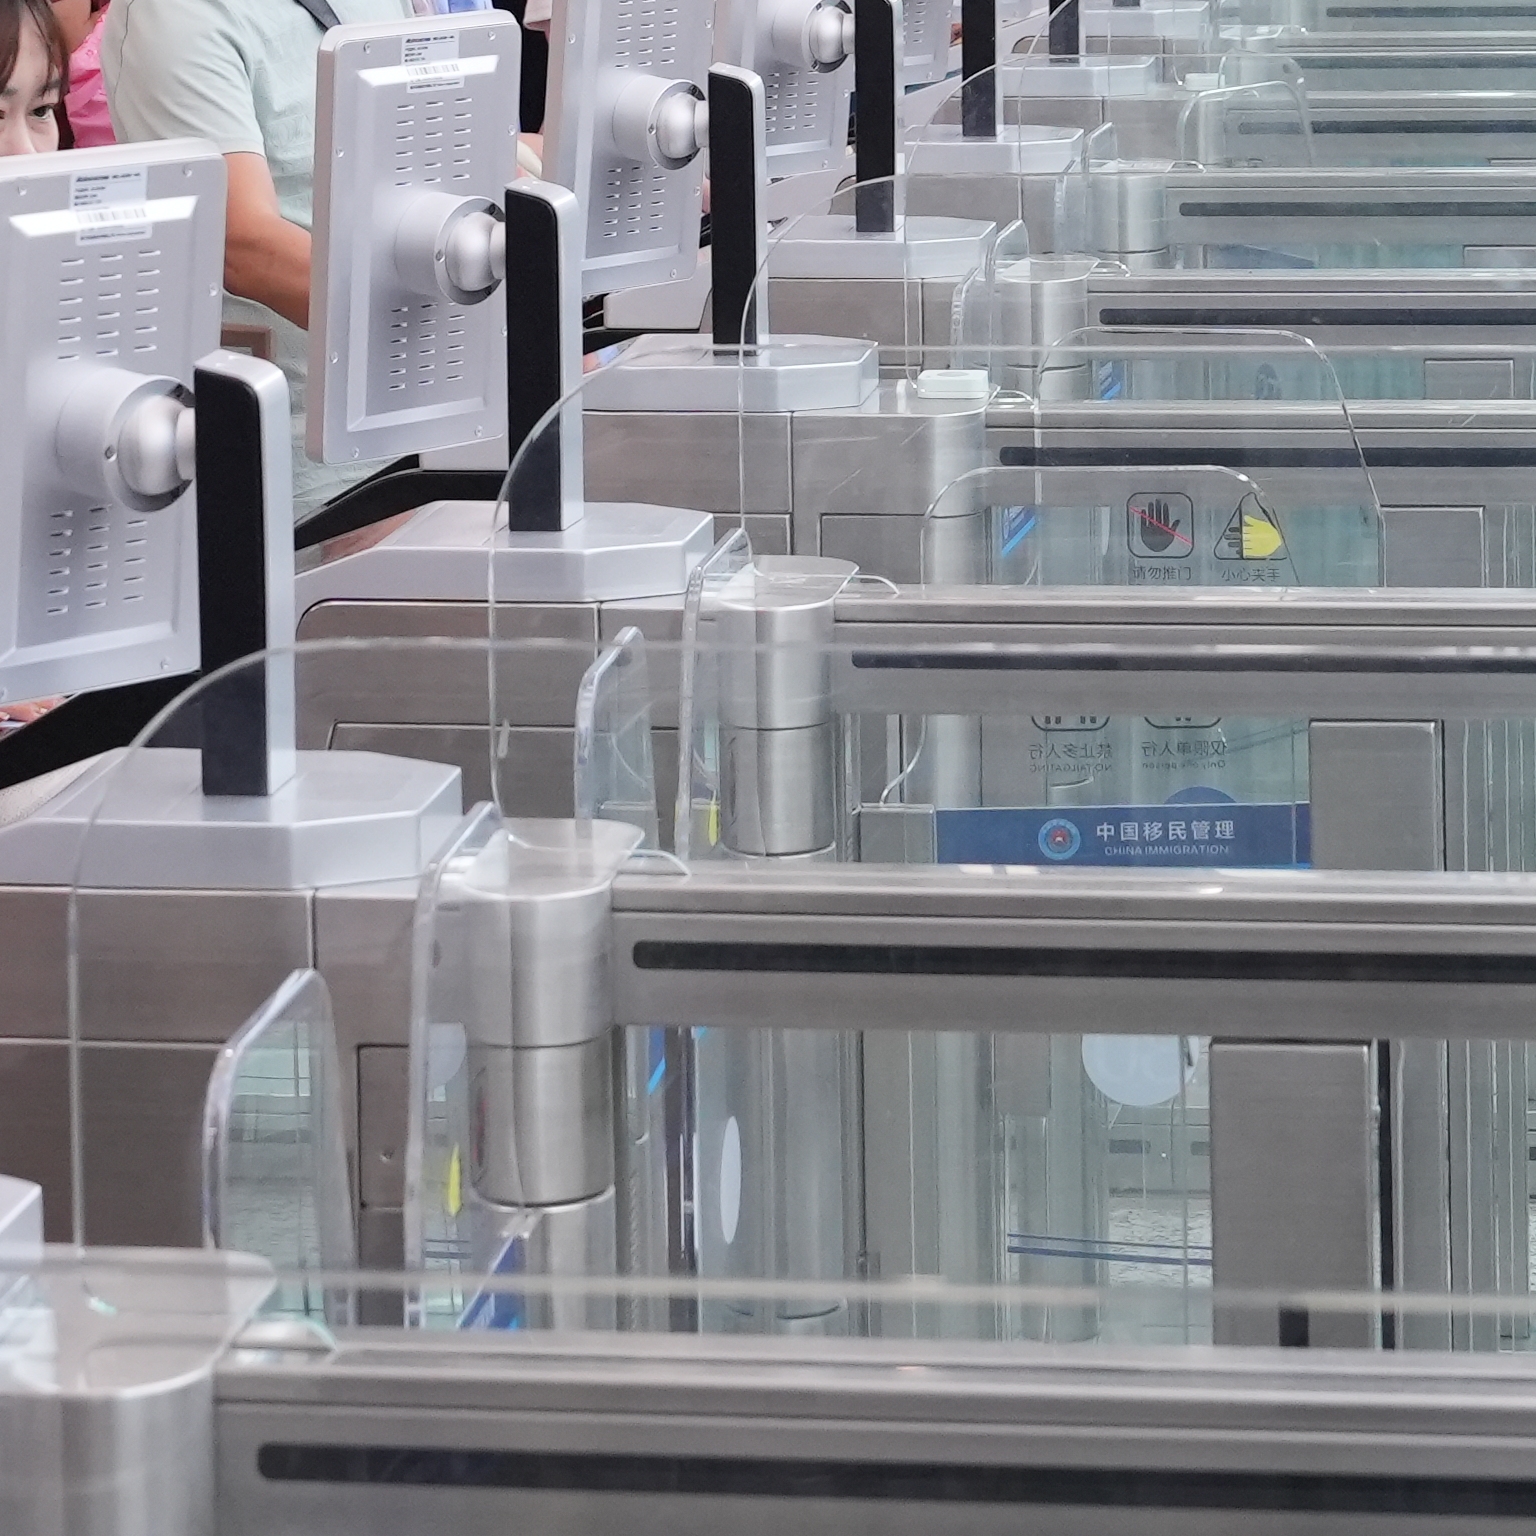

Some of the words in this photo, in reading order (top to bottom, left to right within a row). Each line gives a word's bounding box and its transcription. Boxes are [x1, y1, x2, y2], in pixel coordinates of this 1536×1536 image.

[1132, 566, 1192, 581] 请勿推门
[1221, 567, 1281, 582] 小心夹手
[1096, 819, 1236, 843] 中国移民管理
[1104, 844, 1143, 857] CHINA
[1144, 844, 1230, 856] IMMIGRATION
